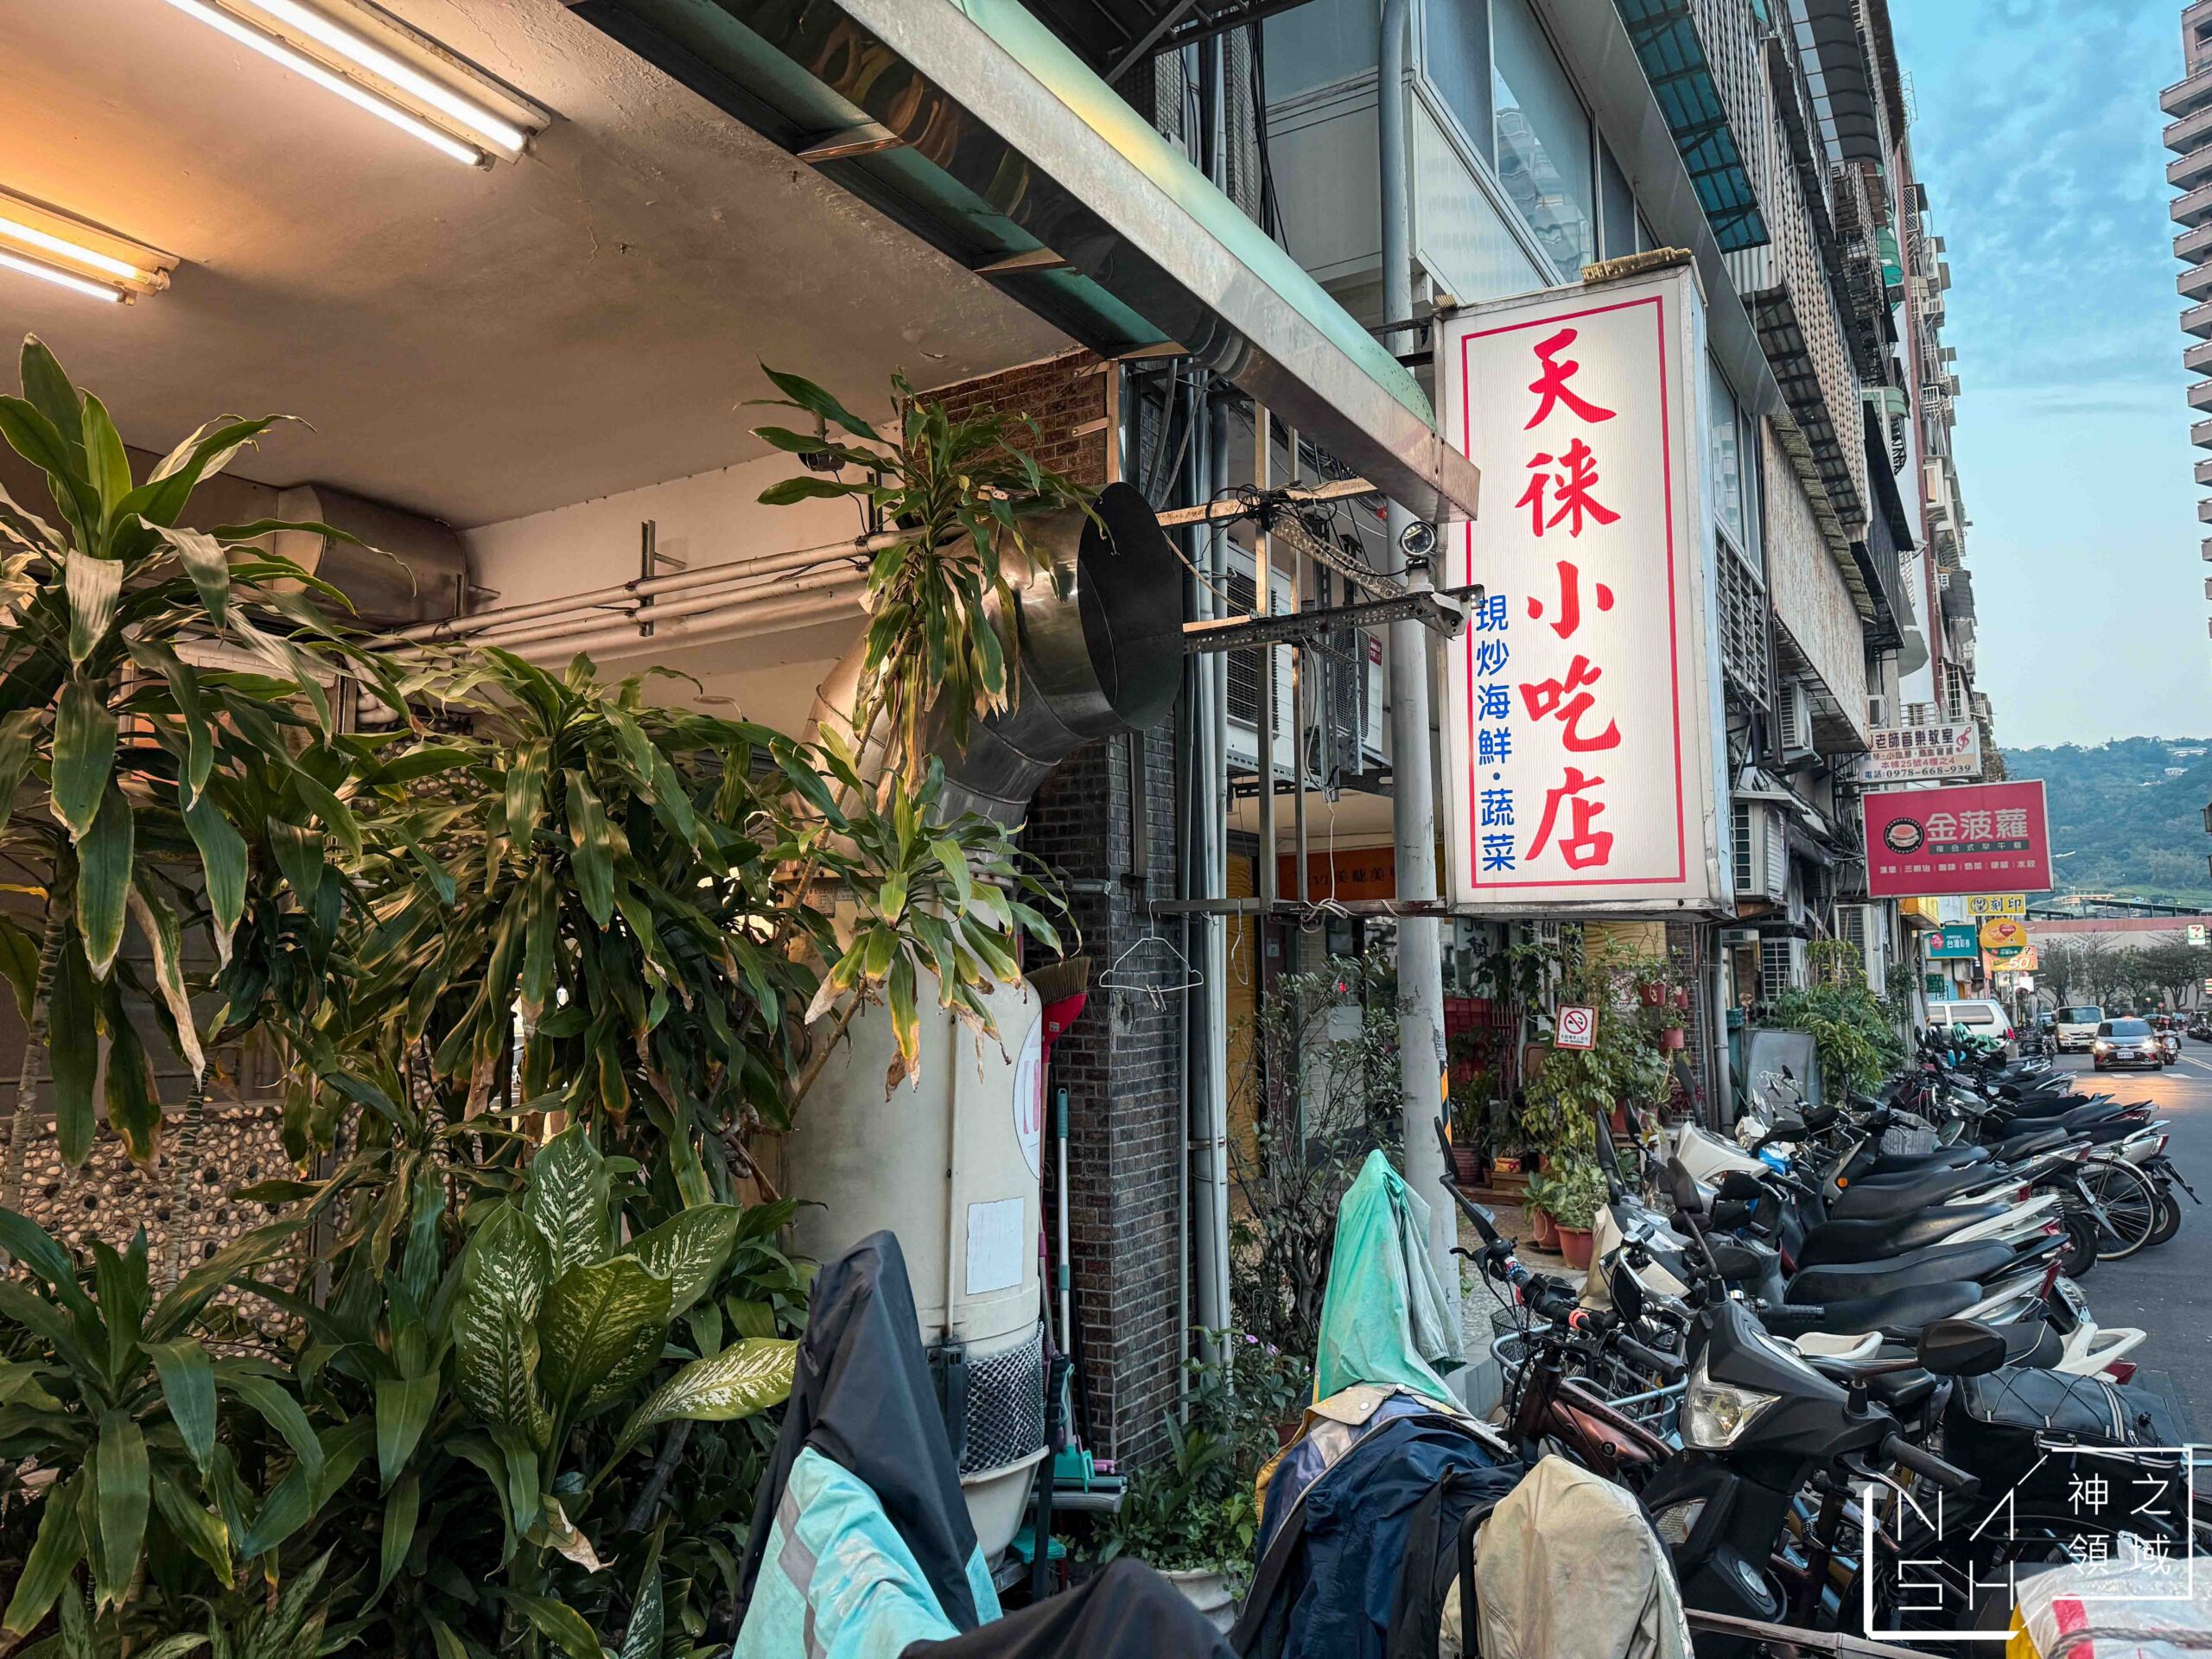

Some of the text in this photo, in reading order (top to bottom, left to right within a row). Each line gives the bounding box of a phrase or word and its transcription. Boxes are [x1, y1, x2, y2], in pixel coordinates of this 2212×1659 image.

[1870, 728, 1955, 749] 老師音樂教室
[1925, 808, 2029, 842] 金菠蘿
[1991, 897, 2023, 912] 刻印
